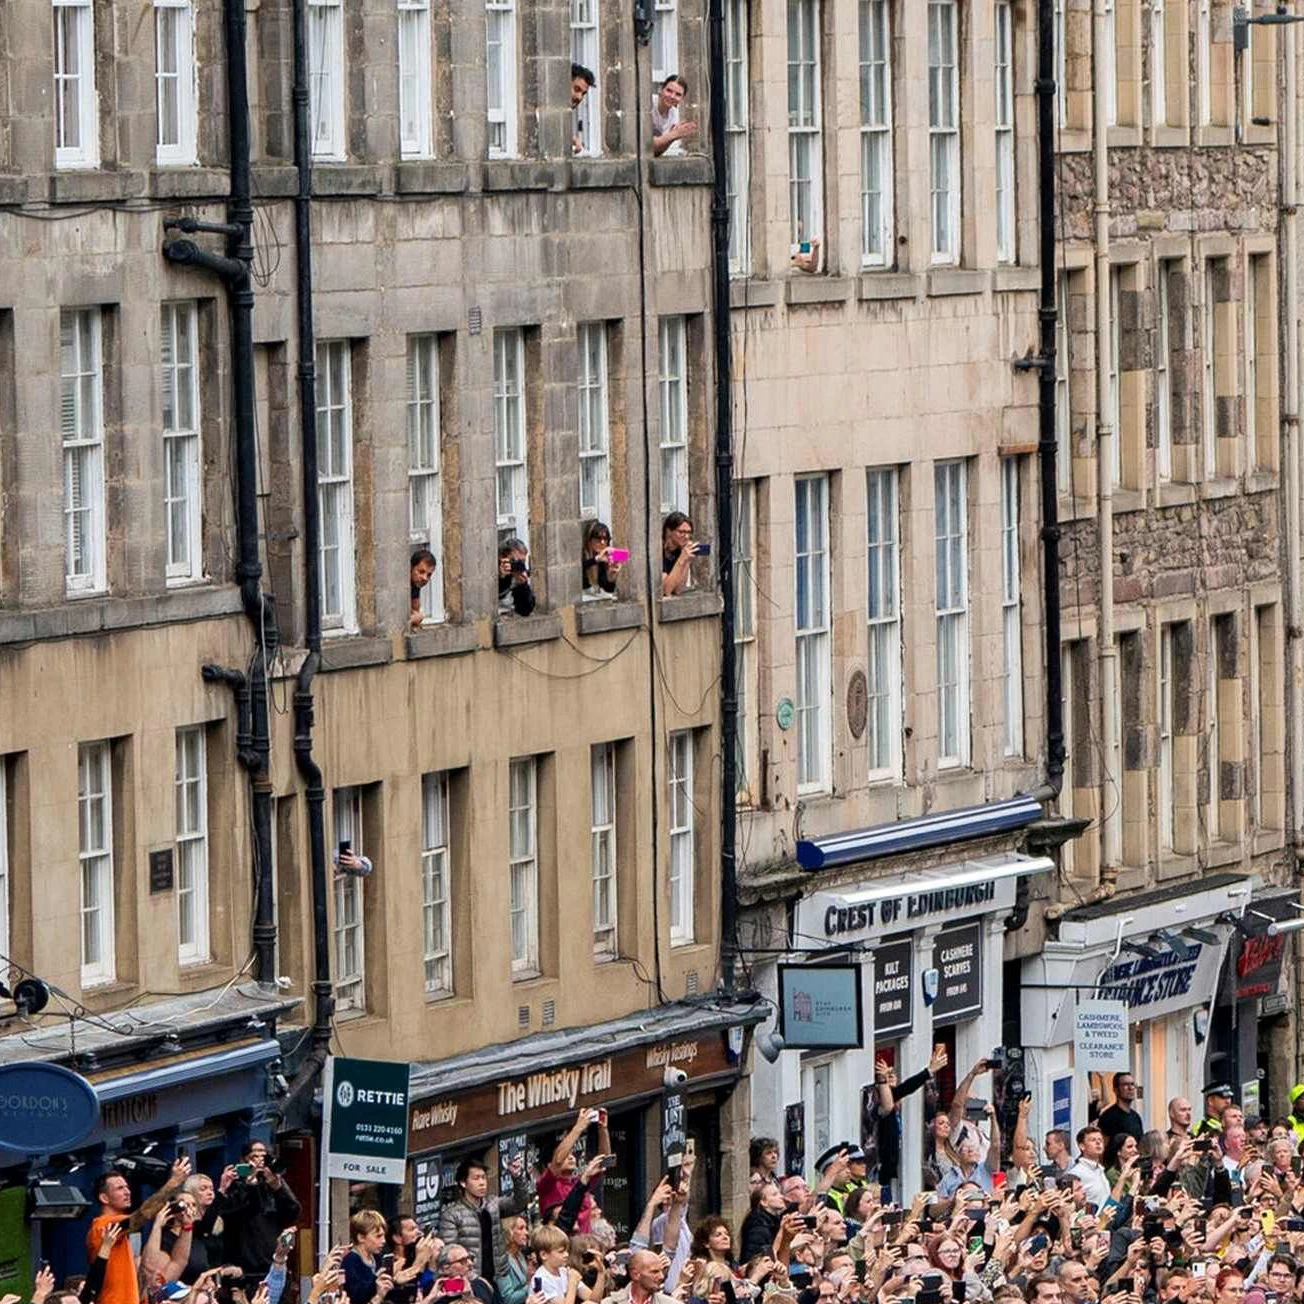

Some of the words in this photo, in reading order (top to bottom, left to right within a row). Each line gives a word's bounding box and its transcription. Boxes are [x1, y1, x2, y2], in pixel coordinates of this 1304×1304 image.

[824, 902, 877, 936] CREST
[940, 943, 974, 963] CASHMERE
[884, 960, 900, 976] KILT
[943, 961, 972, 979] SCARVES
[875, 975, 909, 995] PACKAGES
[1085, 1031, 1091, 1039] &
[1093, 1031, 1119, 1039] TWEED
[646, 1044, 670, 1069] Whisky
[671, 1041, 698, 1064] Tastings
[1079, 1043, 1124, 1051] CLEARANCE
[1089, 1051, 1115, 1060] STORE
[498, 1079, 526, 1115] The
[526, 1067, 580, 1109] Whisky
[581, 1058, 612, 1095] Trail
[357, 1089, 405, 1106] RETTIE
[412, 1108, 430, 1131] Rare
[430, 1100, 458, 1126] Whisky
[355, 1123, 372, 1132] 0131
[373, 1125, 386, 1133] 220
[386, 1126, 403, 1135] 4160
[355, 1133, 394, 1144] rettie.co.uk
[343, 1162, 360, 1172] FOR
[366, 1165, 387, 1175] SALE
